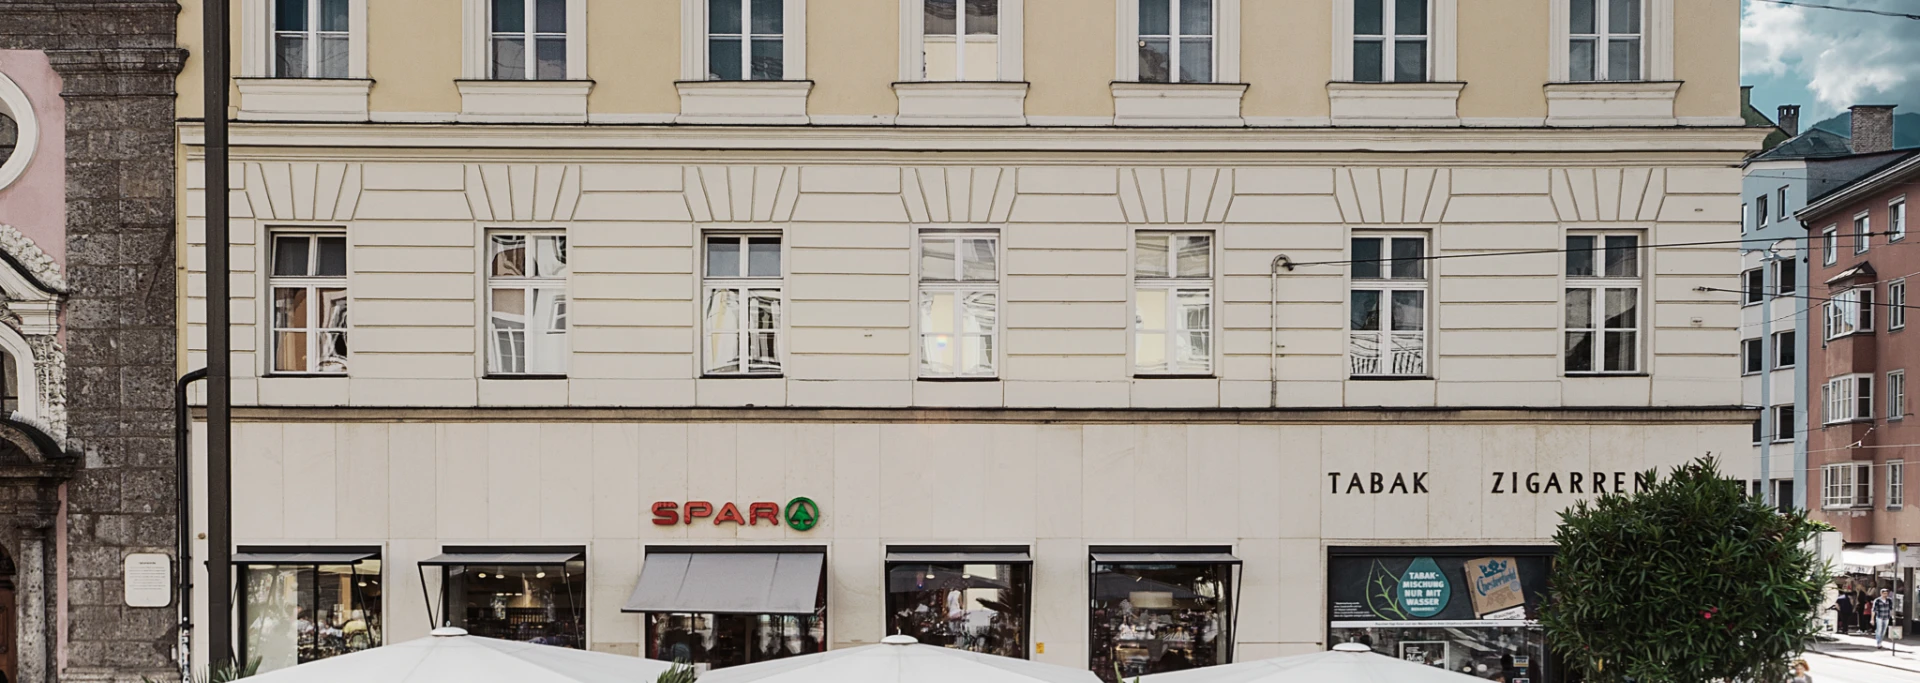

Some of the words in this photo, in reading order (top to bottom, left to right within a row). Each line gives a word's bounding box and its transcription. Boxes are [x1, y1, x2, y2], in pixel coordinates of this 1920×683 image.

[1328, 471, 1429, 494] TABAK
[1491, 471, 1652, 494] ZIGARREN
[652, 501, 779, 526] SPAR
[1409, 572, 1440, 580] TABAK-
[1402, 581, 1445, 589] MISCHUNG
[1404, 590, 1423, 598] NUR
[1406, 598, 1440, 606] WASSER
